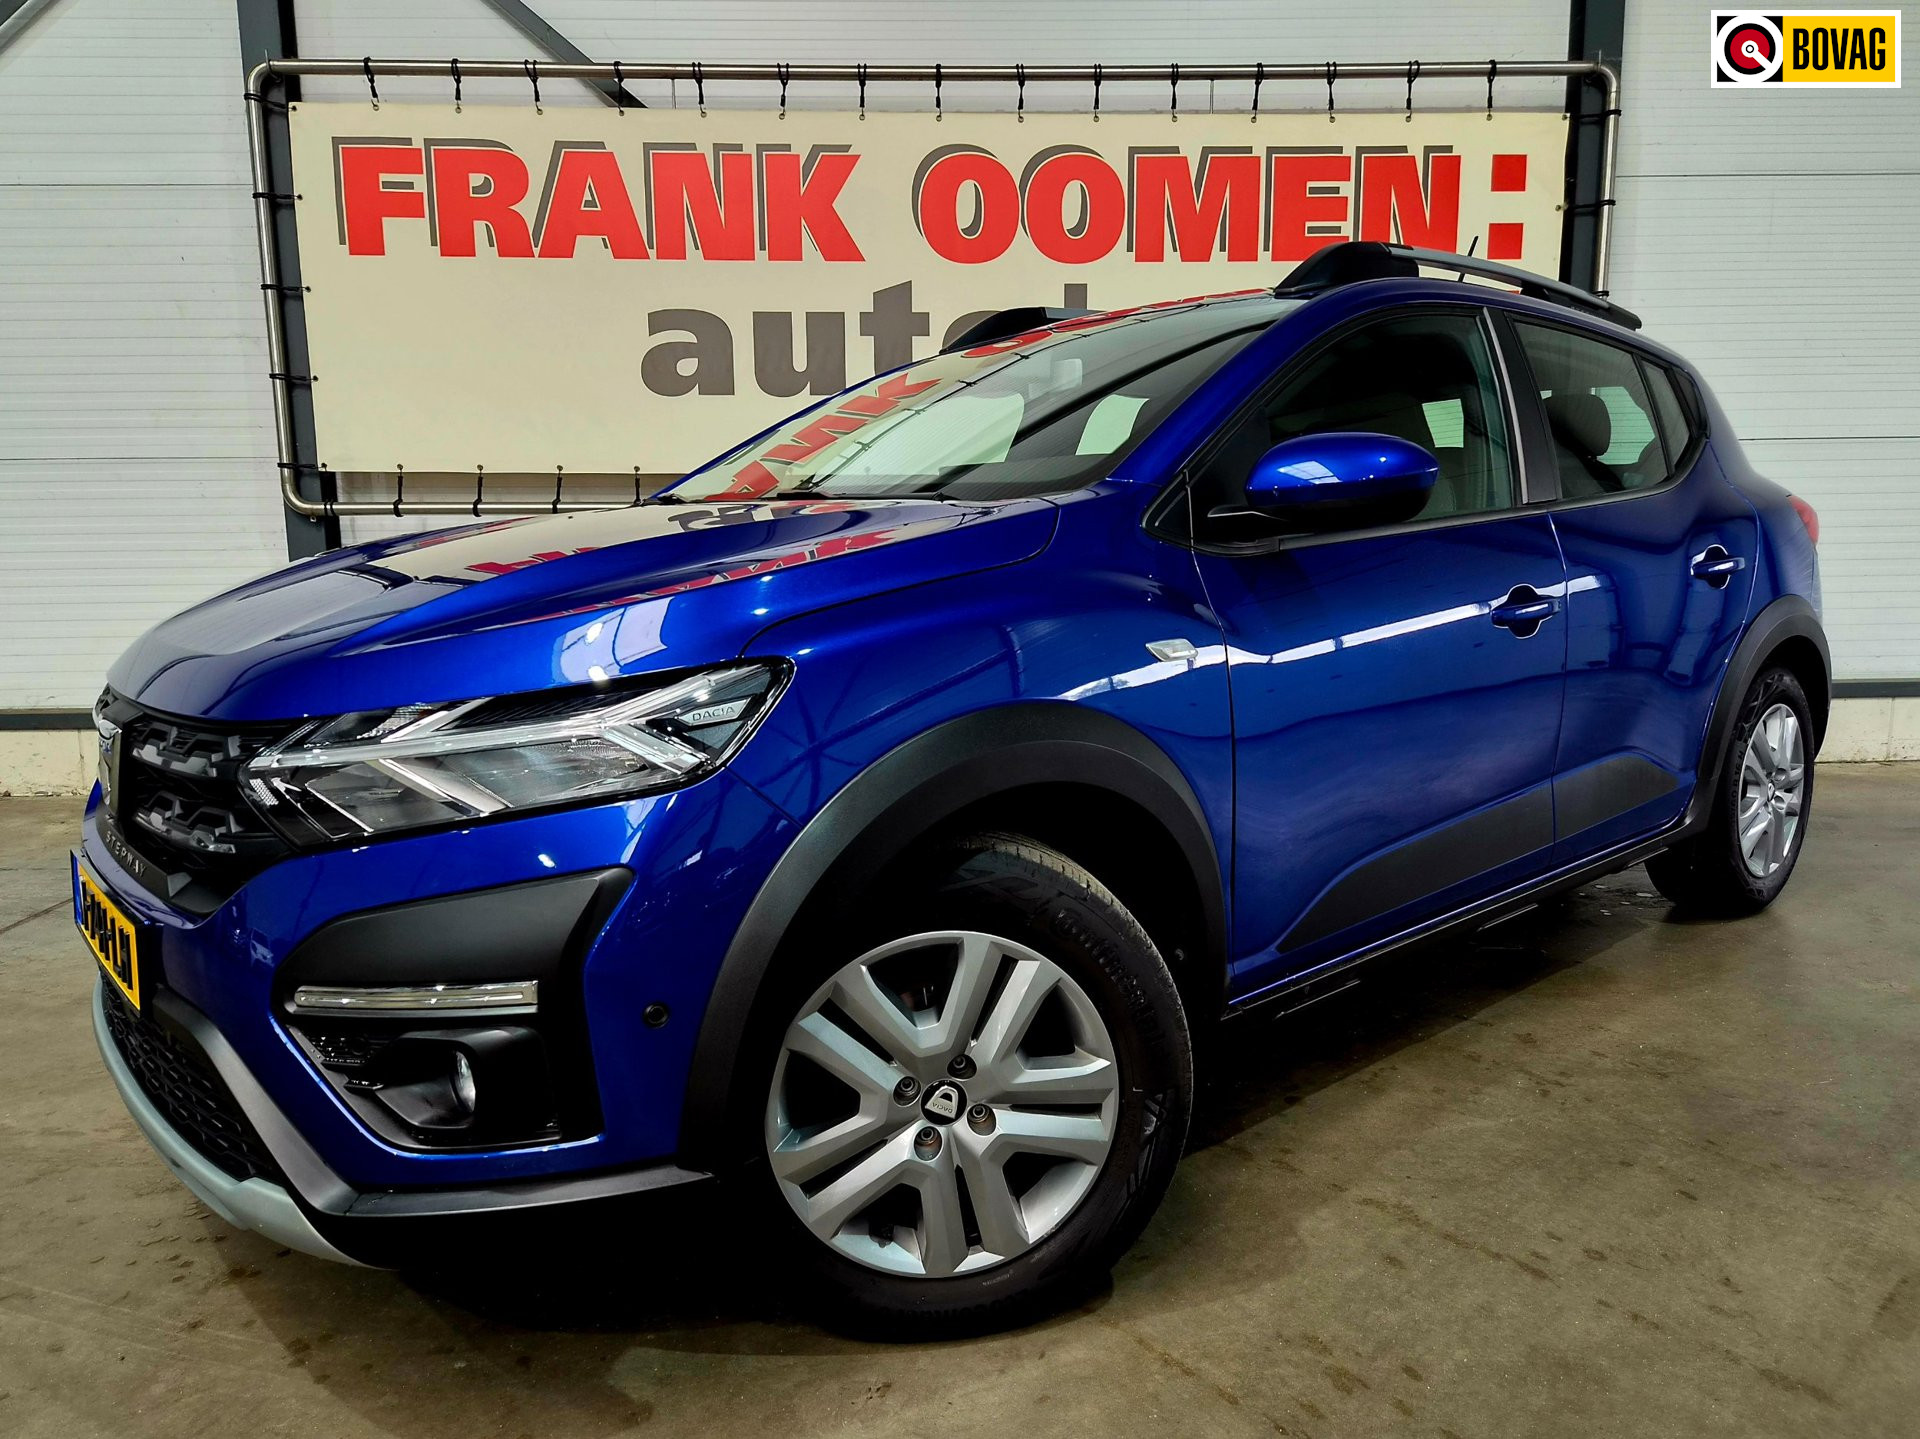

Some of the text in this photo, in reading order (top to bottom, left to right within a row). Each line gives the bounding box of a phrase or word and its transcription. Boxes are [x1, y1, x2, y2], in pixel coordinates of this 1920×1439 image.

[332, 137, 866, 262] FRANK
[691, 706, 735, 722] DACIA
[105, 830, 147, 879] STEPWAY
[931, 1102, 953, 1114] DACIA
